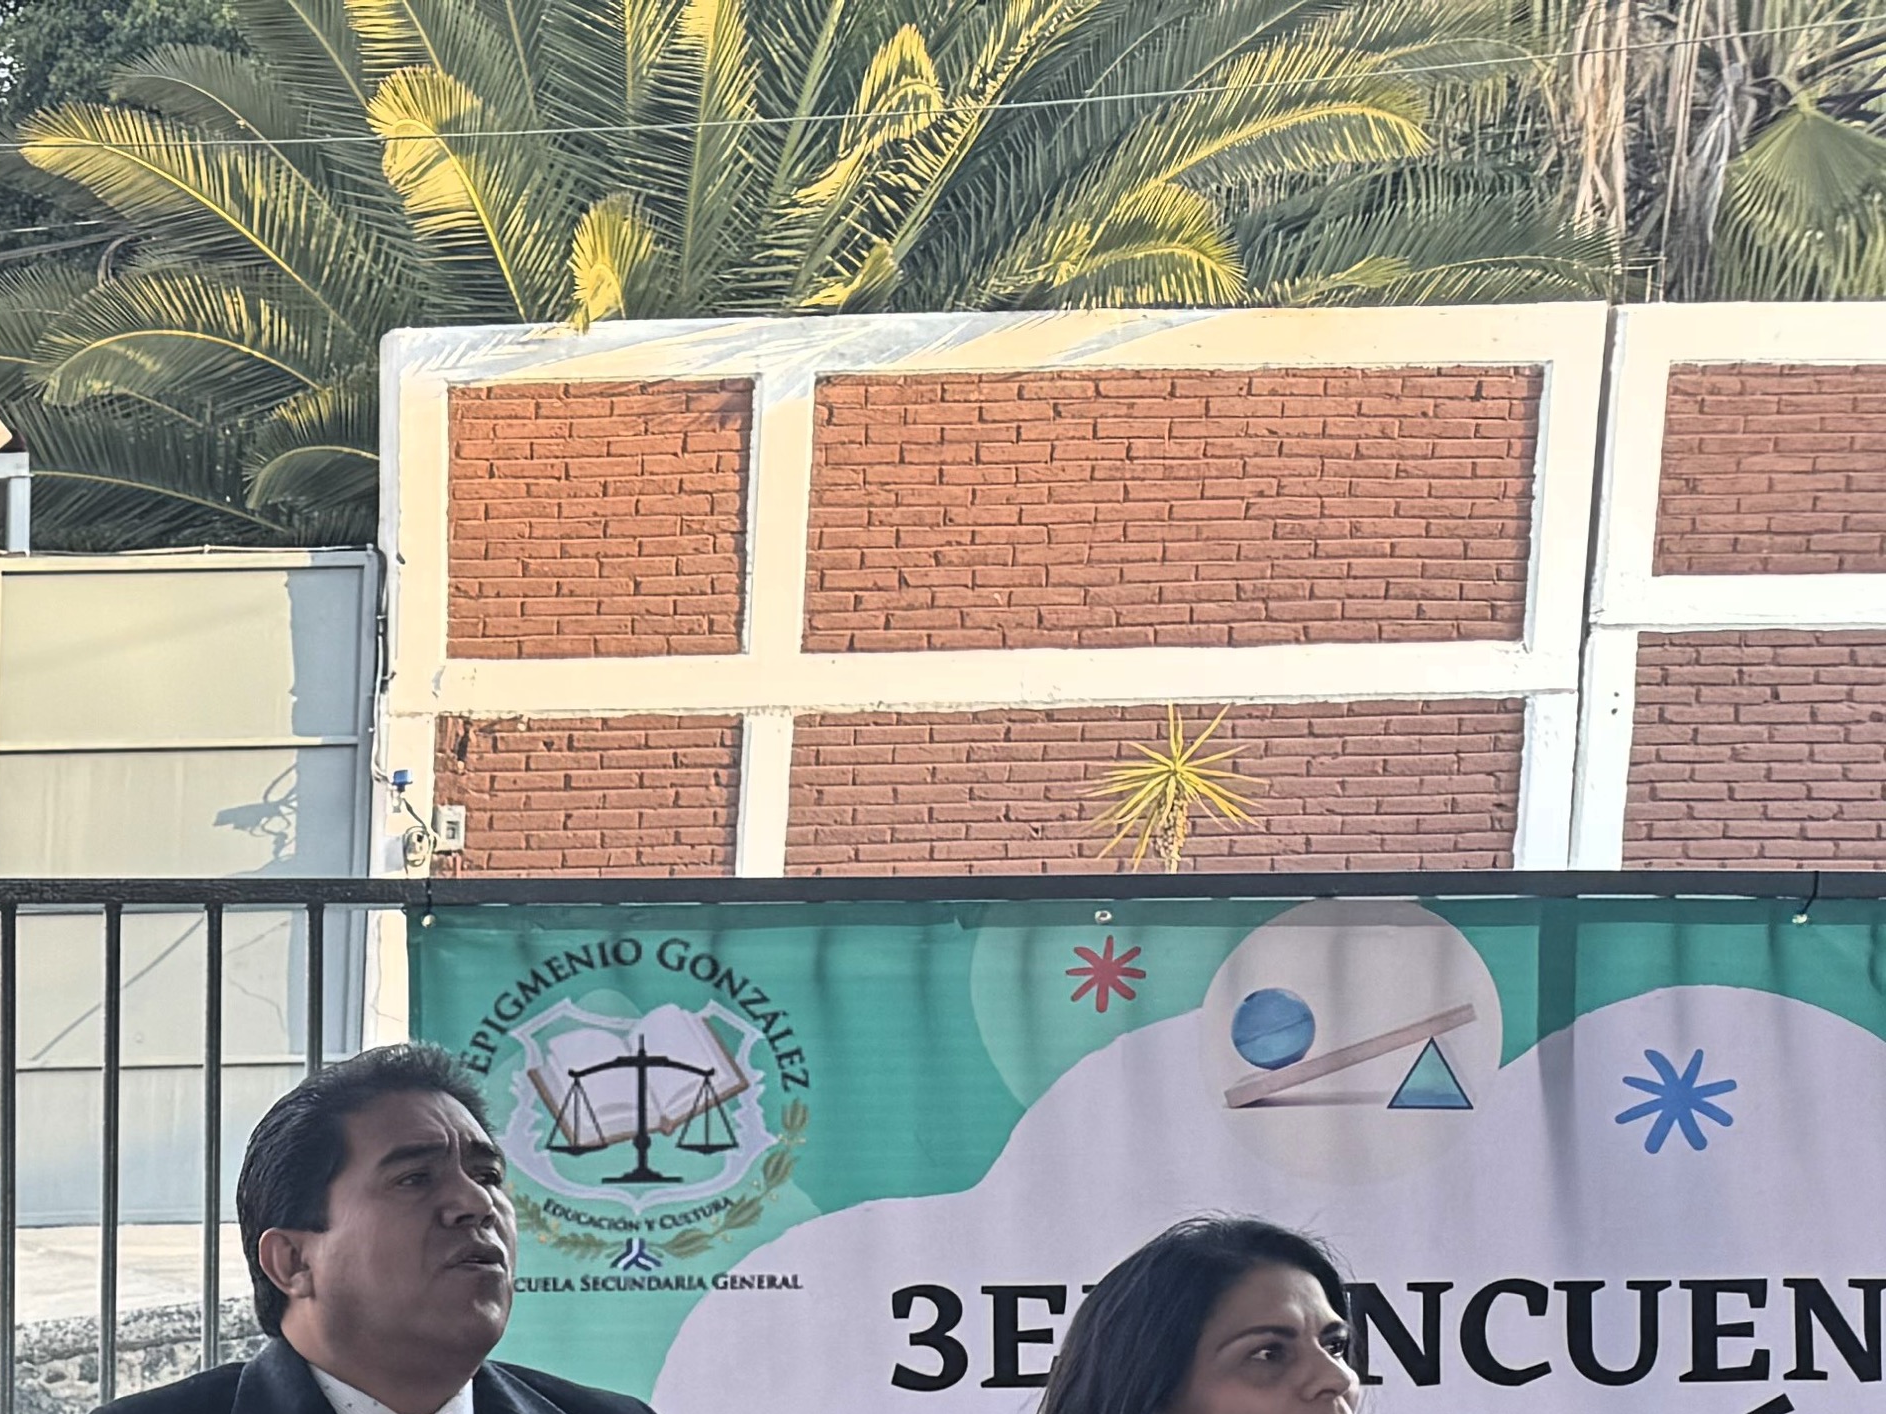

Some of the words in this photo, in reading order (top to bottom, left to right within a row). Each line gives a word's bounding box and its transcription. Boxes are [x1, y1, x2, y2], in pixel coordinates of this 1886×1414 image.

[462, 937, 643, 1076] EPIGMENIO
[656, 937, 811, 1093] GONZÁLEZ
[512, 1276, 575, 1293] CUELA
[580, 1273, 708, 1292] SECUNDARIA
[711, 1271, 804, 1290] GENERAL
[890, 1283, 1098, 1392] 3E
[1343, 1277, 1886, 1387] NCUEN
